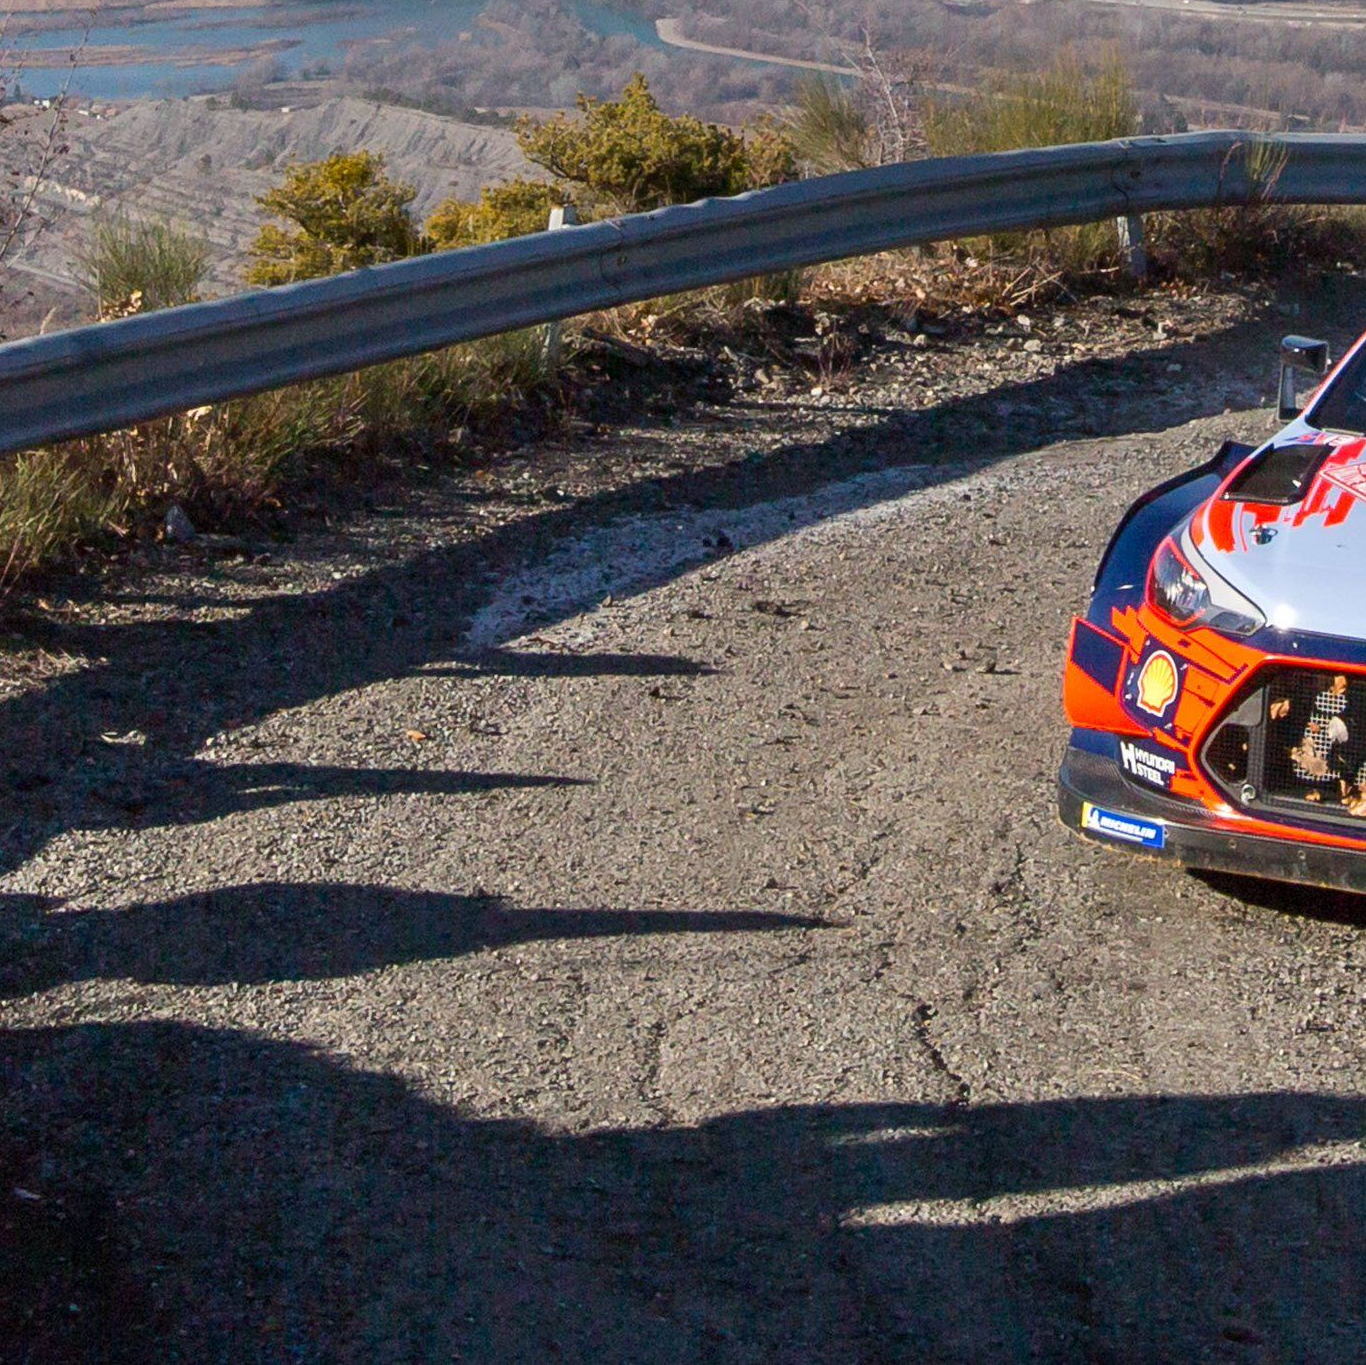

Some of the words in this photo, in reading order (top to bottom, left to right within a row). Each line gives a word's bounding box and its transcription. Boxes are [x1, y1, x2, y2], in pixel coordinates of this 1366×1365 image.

[1135, 747, 1176, 775] HYUNDAI
[1136, 761, 1166, 787] STEEL
[1099, 815, 1157, 840] MICHELIN
